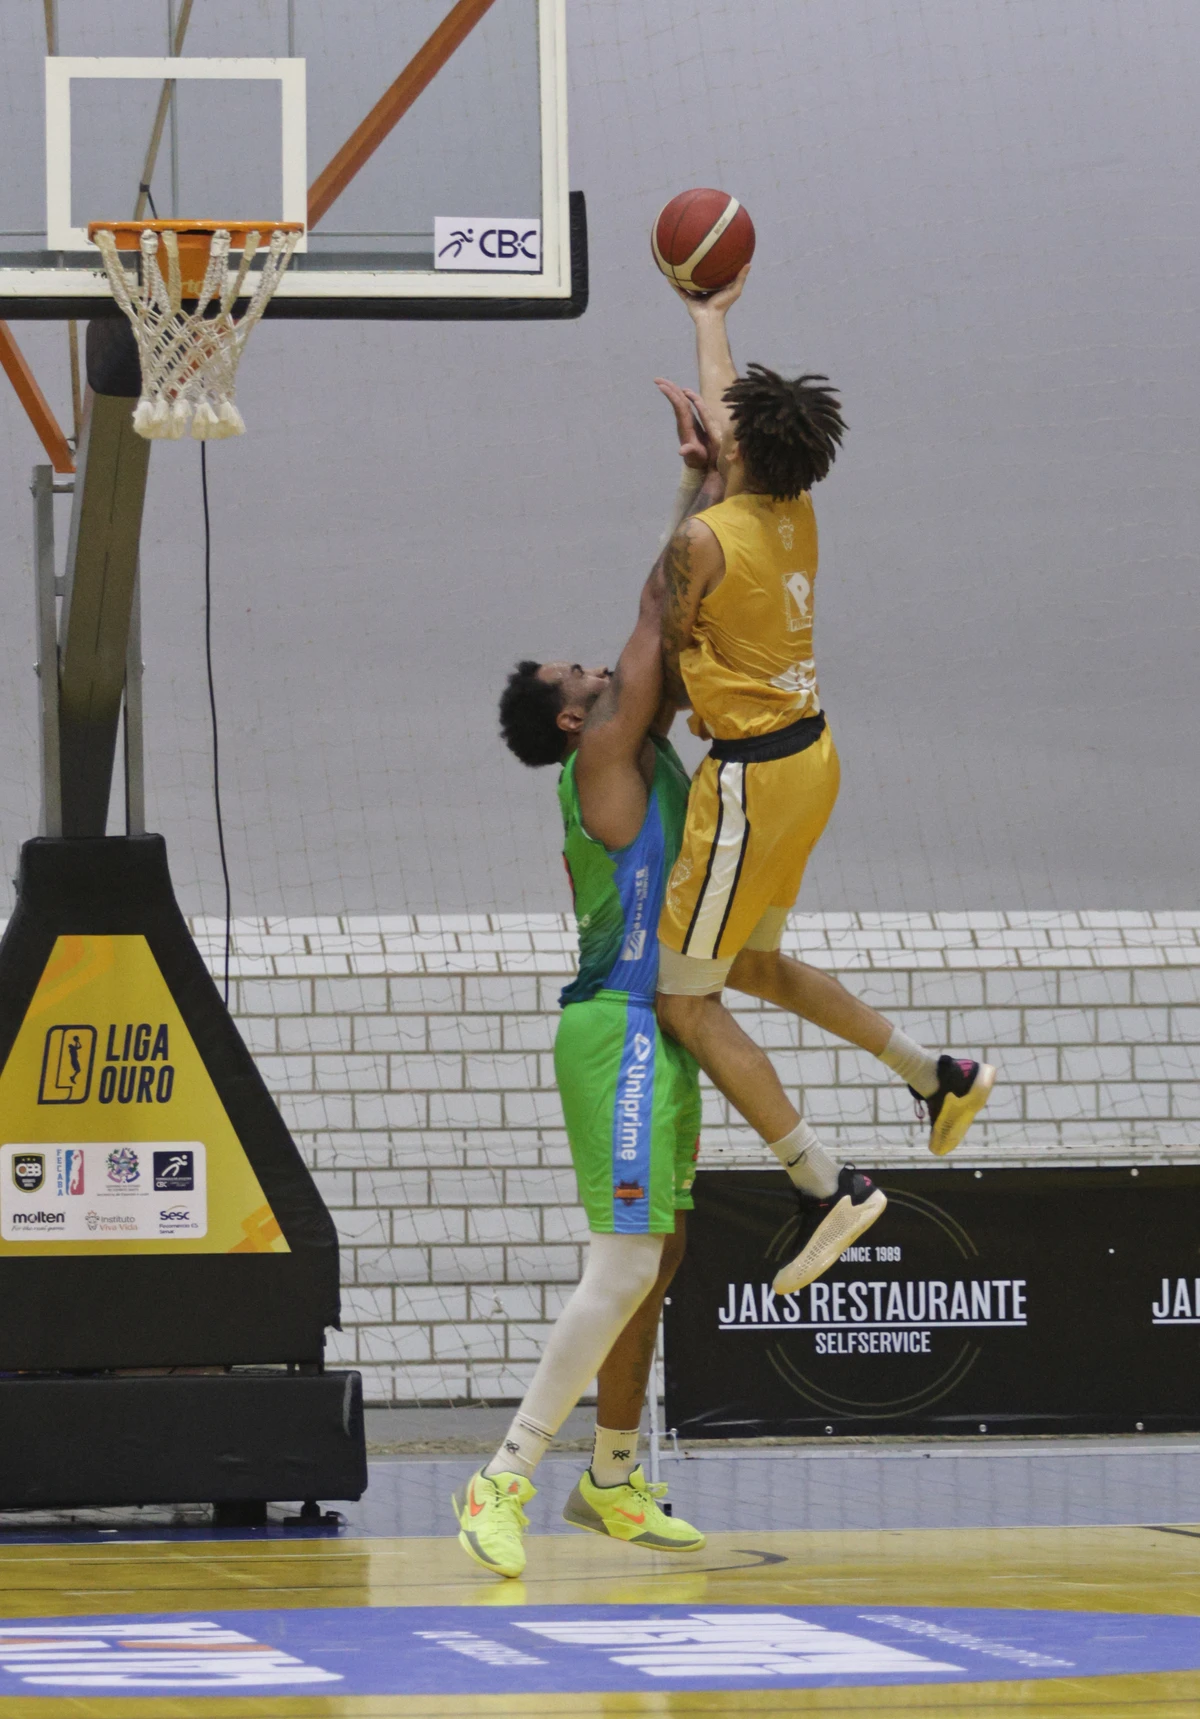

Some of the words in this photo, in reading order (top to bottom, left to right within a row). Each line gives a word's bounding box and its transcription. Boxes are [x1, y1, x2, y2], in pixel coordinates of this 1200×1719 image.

[479, 229, 537, 259] CBC
[105, 1024, 168, 1061] LIGA
[98, 1065, 175, 1104] OURO
[618, 1065, 646, 1160] Uniprime
[13, 1211, 65, 1223] molten
[101, 1215, 135, 1223] Instituto
[120, 1223, 138, 1231] Vida
[160, 1210, 190, 1221] Sesc
[840, 1247, 872, 1262] SINCE
[875, 1246, 901, 1262] 1989
[718, 1283, 800, 1323] JAKS
[811, 1280, 1027, 1322] RESTAURANTE
[815, 1331, 931, 1354] SELFSERVICE
